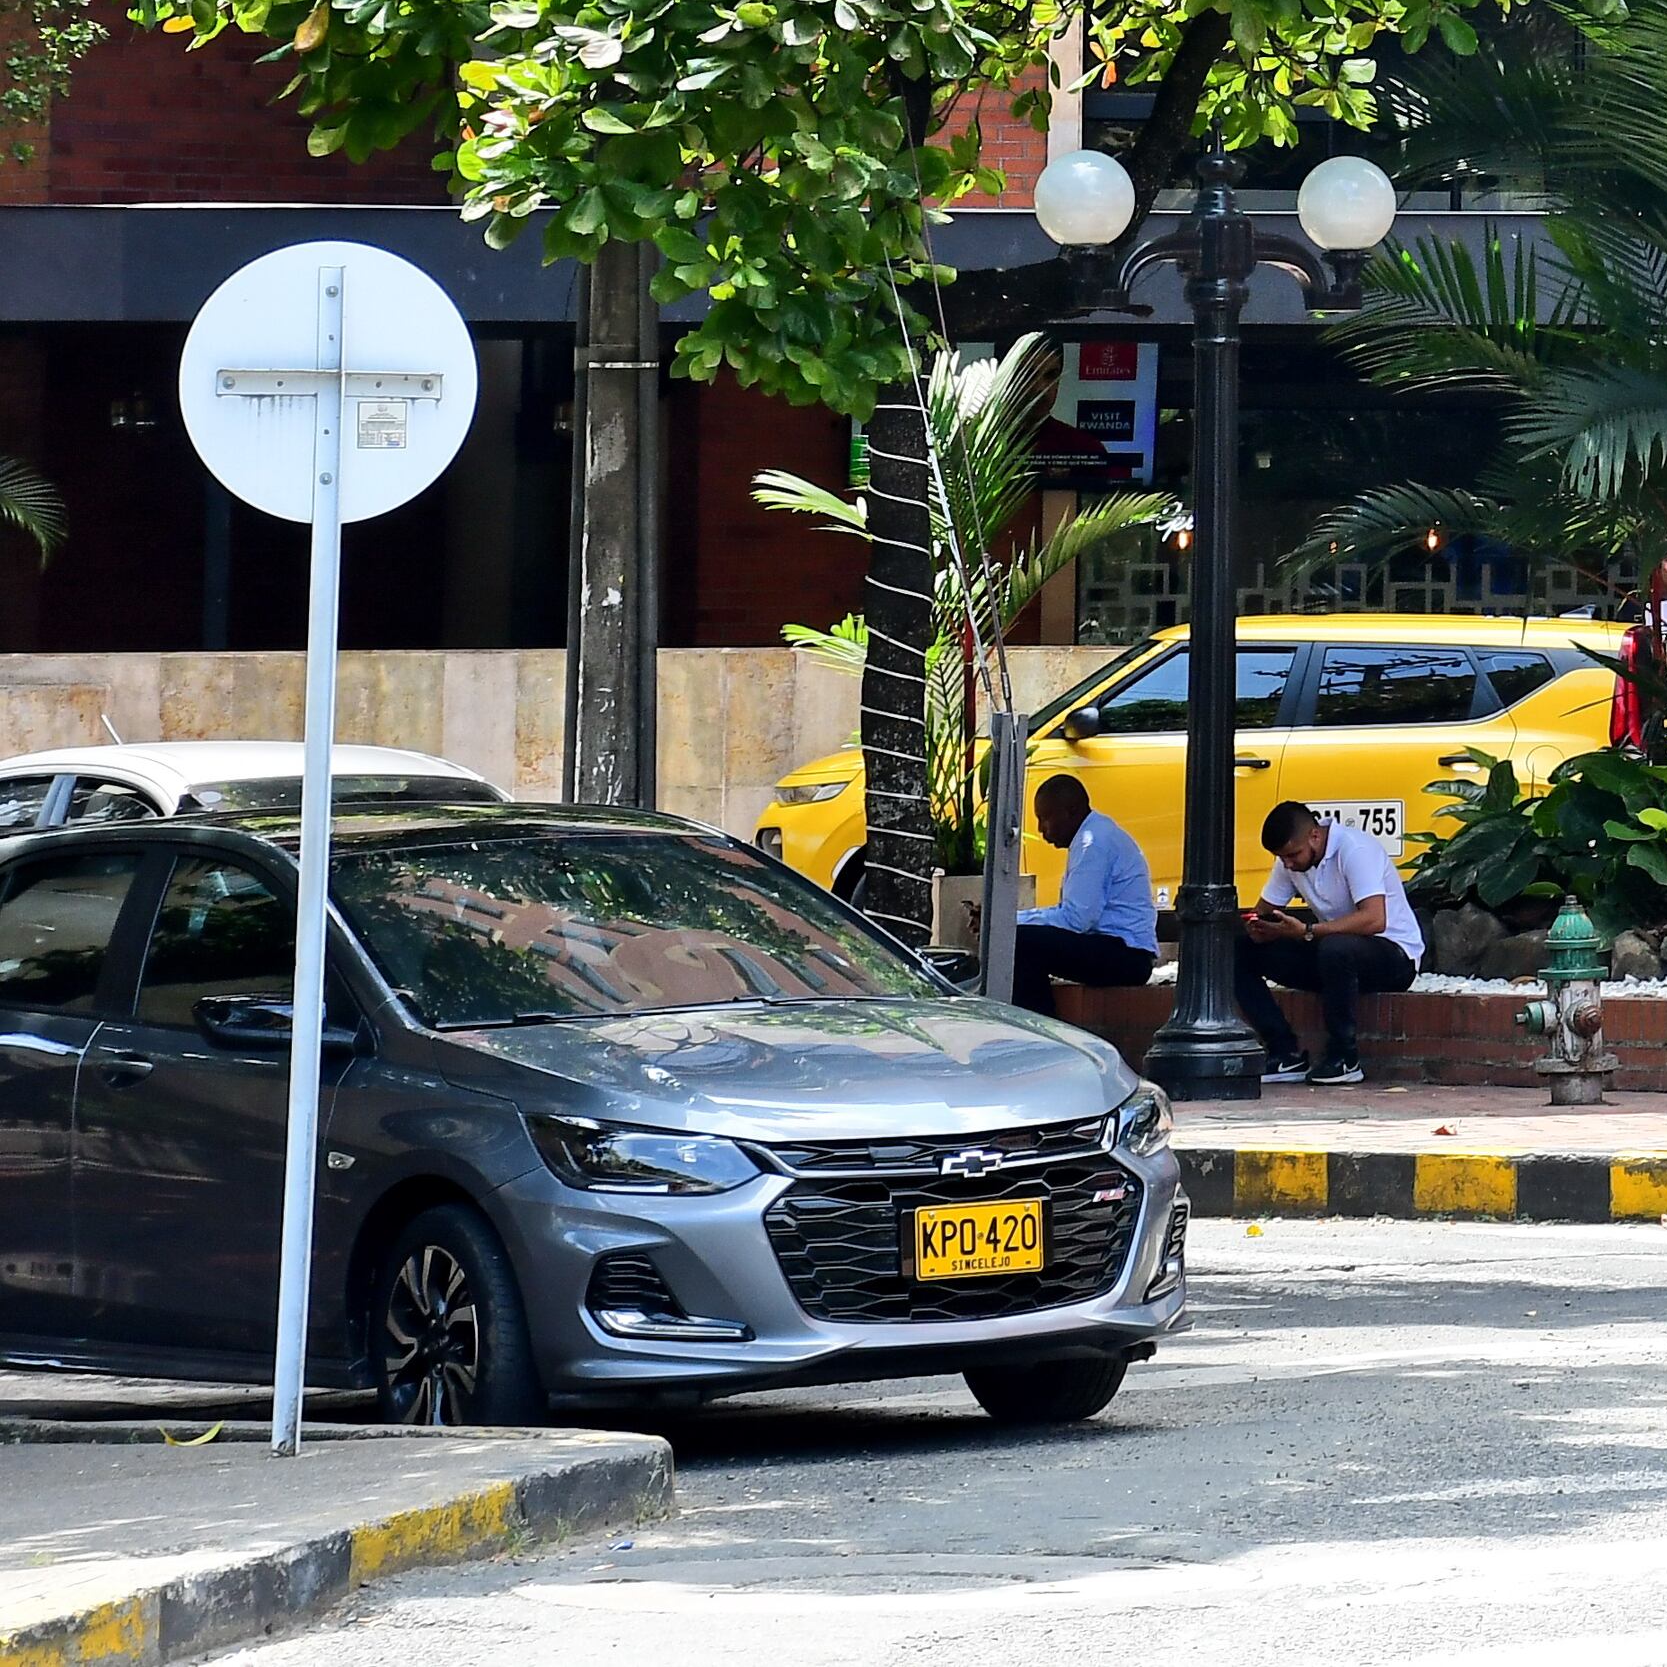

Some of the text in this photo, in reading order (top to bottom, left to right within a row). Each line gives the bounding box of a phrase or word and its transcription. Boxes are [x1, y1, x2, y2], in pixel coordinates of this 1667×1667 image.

[1085, 365, 1131, 375] Emirates
[1091, 412, 1121, 421] VISIT
[1079, 421, 1131, 430] RWANDA
[1359, 808, 1396, 836] 755
[922, 1213, 1037, 1259] KPO 420
[951, 1258, 1010, 1271] SINCELEJO
